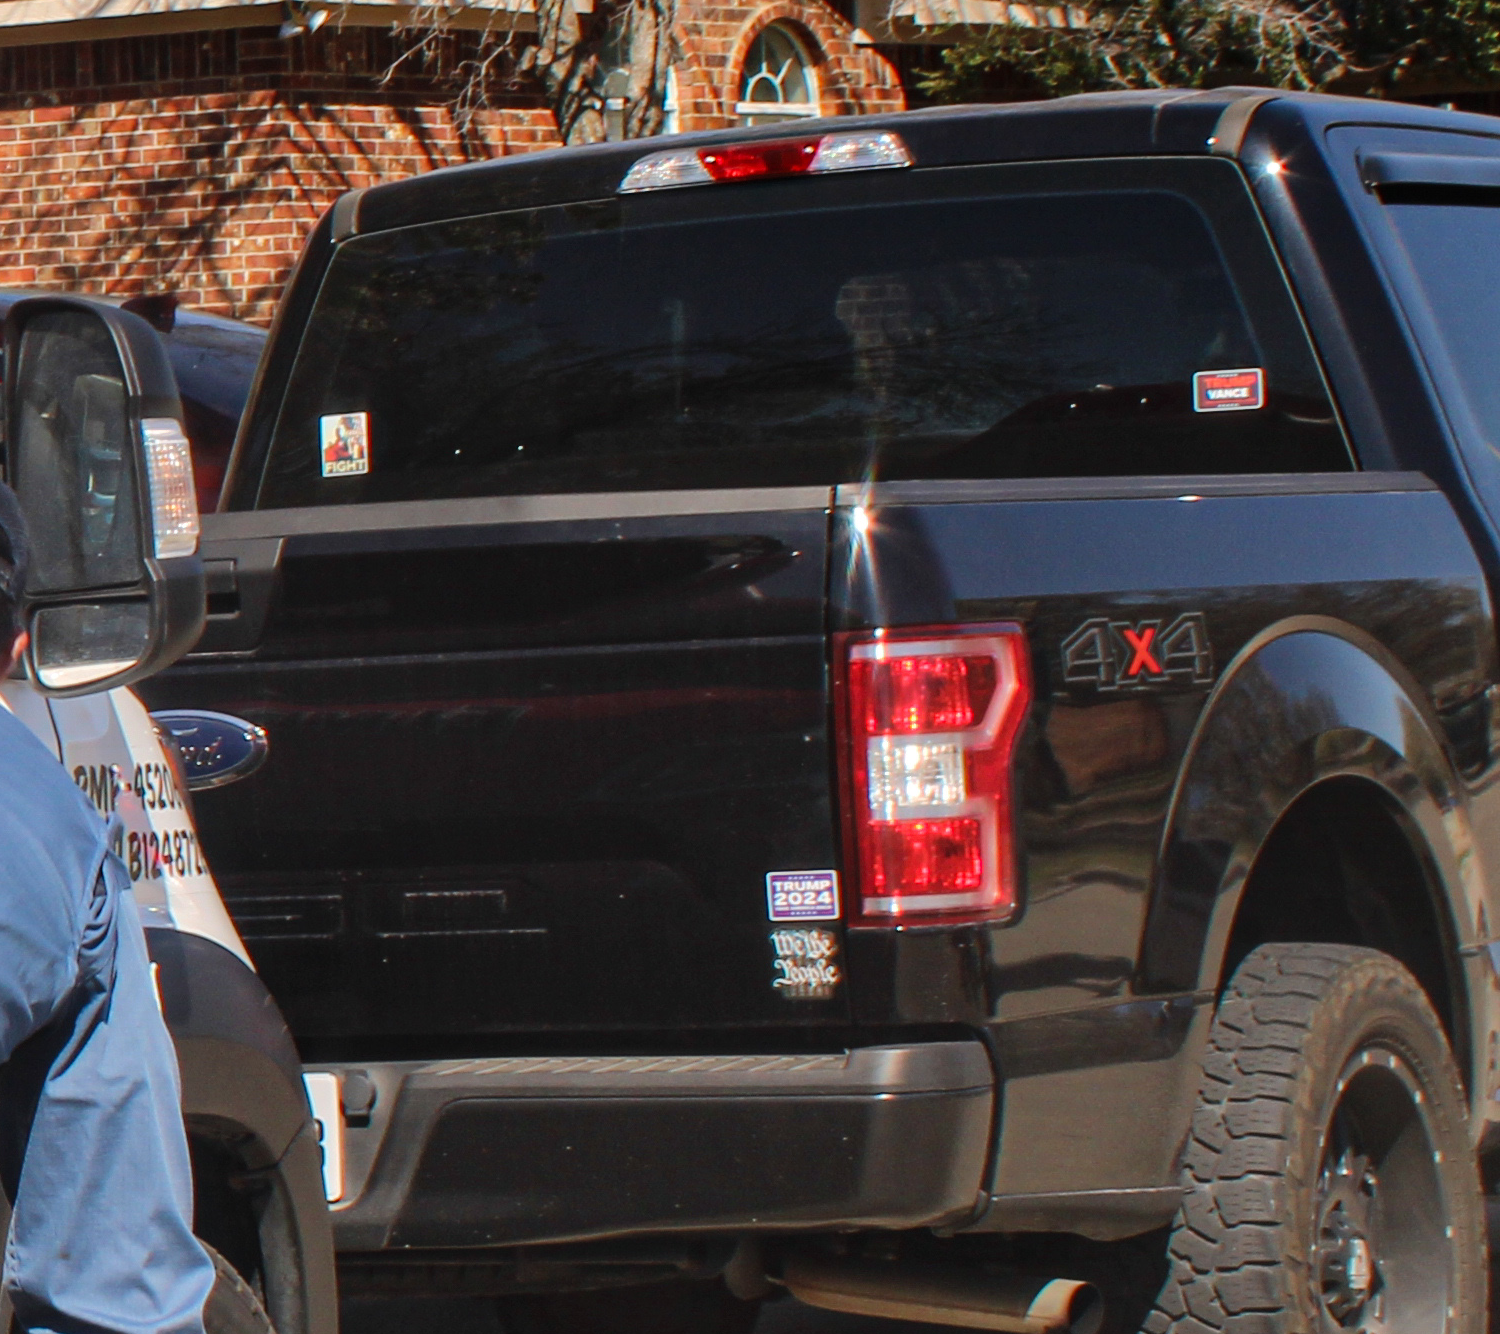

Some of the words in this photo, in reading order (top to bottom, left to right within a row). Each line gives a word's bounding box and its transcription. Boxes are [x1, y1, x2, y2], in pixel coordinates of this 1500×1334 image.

[1207, 387, 1250, 400] VANCE
[326, 460, 367, 474] FIGHT
[772, 880, 832, 892] TRUMP
[773, 891, 833, 906] 2024
[771, 958, 840, 988] People
